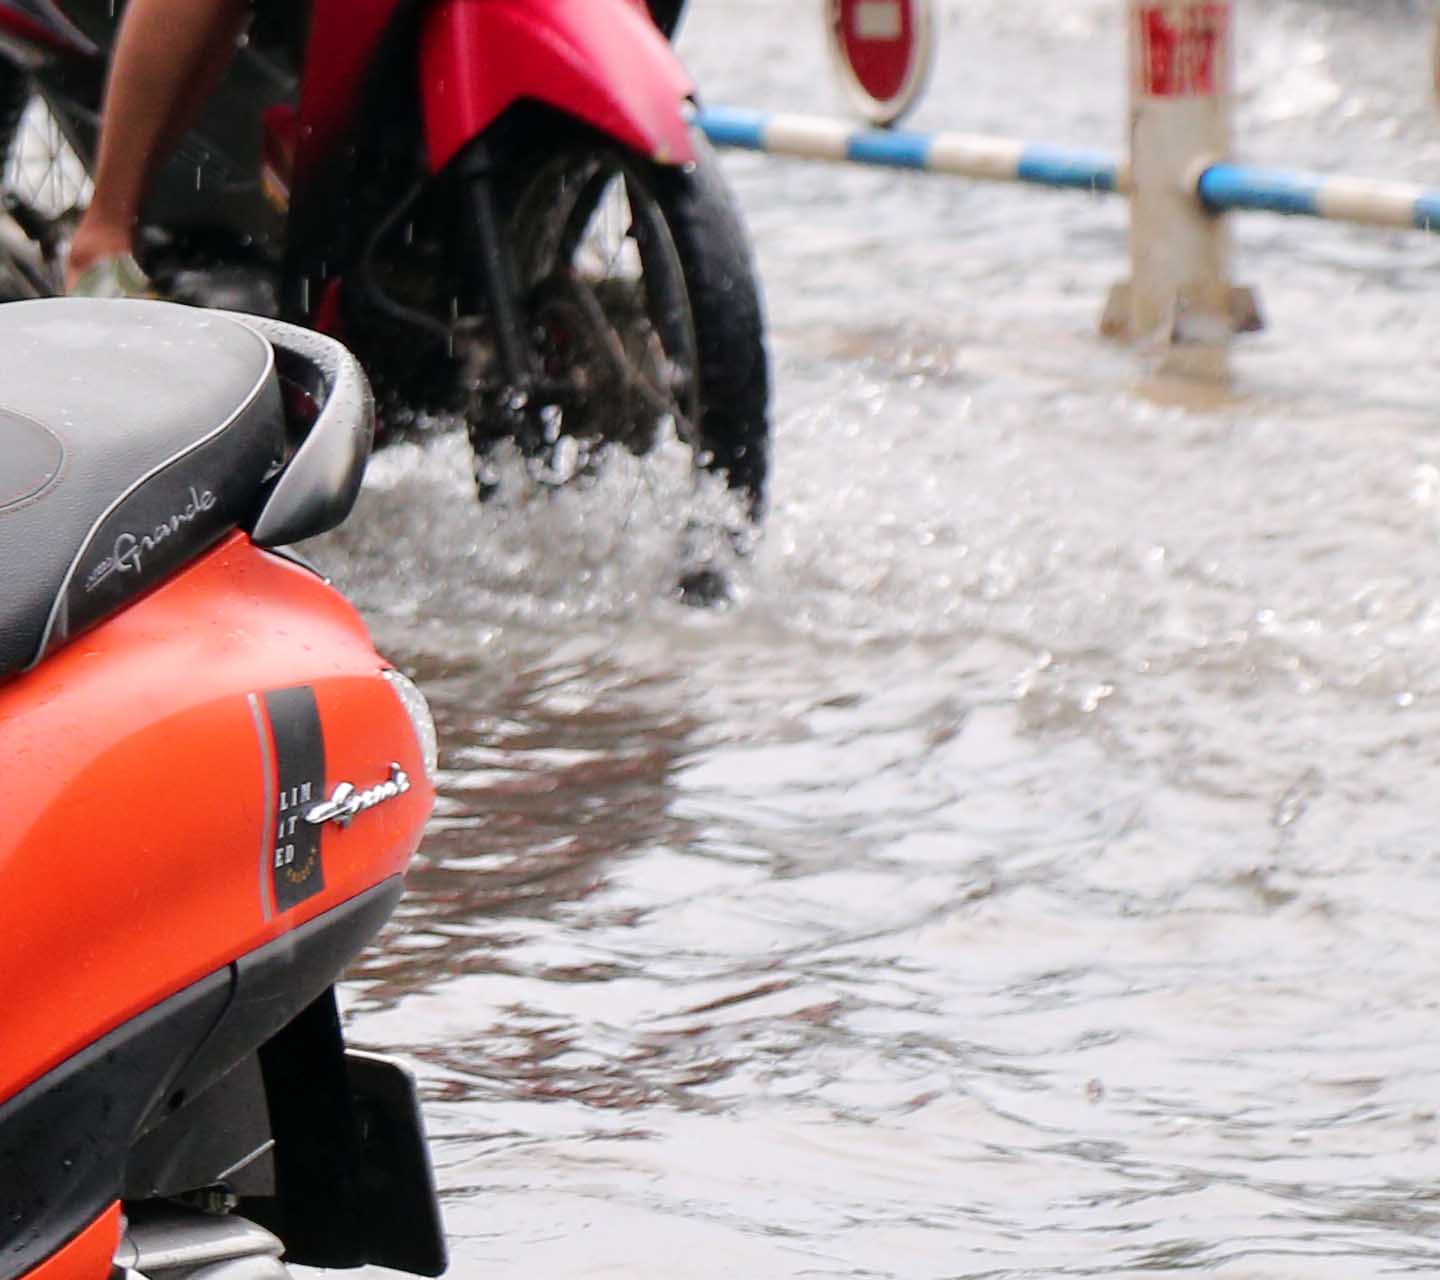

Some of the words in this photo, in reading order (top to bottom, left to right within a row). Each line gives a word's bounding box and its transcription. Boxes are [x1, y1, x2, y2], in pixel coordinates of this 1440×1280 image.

[112, 486, 217, 574] Grande
[280, 782, 312, 811] LIM
[274, 844, 295, 868] ED
